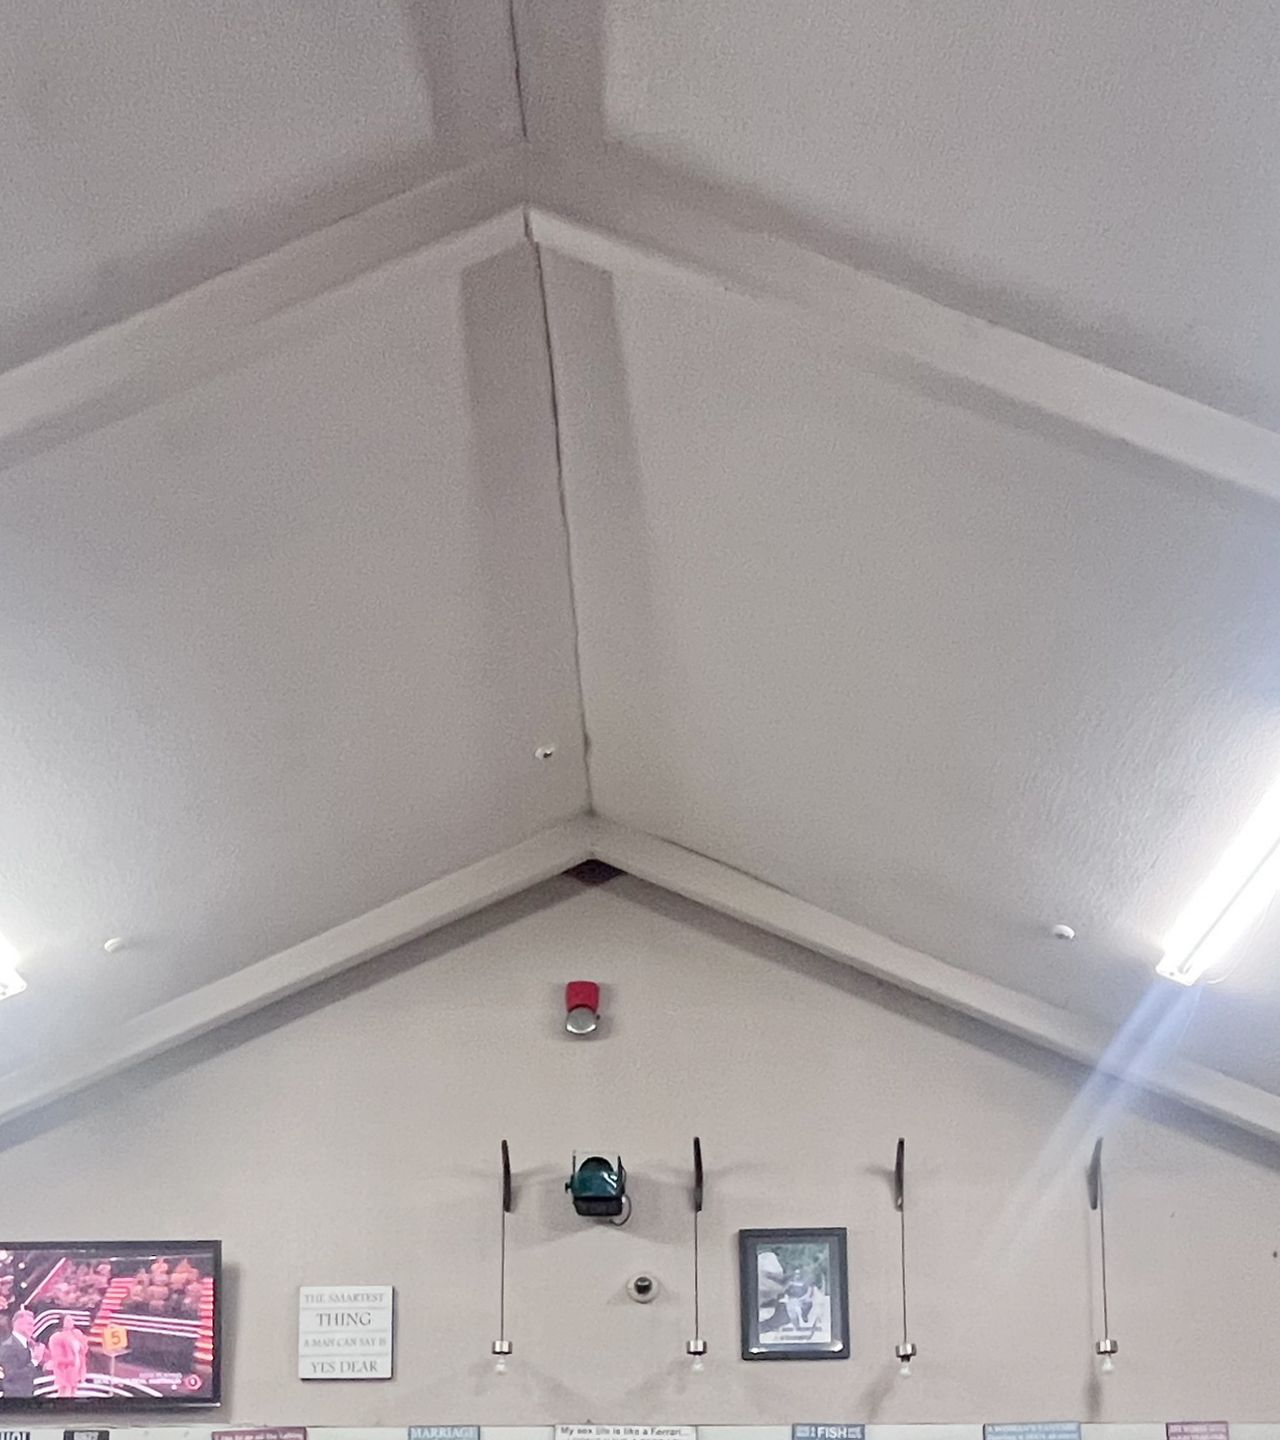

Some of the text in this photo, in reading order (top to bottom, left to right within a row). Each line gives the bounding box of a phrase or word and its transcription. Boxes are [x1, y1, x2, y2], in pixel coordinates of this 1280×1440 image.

[304, 1292, 384, 1303] THE SMARTEST
[316, 1312, 371, 1326] THING
[111, 1332, 121, 1345] 5
[304, 1339, 309, 1347] A
[311, 1339, 335, 1347] MAN
[337, 1338, 357, 1347] CAN
[360, 1337, 376, 1346] SAY
[311, 1360, 378, 1373] YES DEAR
[410, 1427, 477, 1438] MARRIAGE
[561, 1426, 575, 1436] My
[613, 1427, 621, 1435] is
[623, 1427, 640, 1435] like
[817, 1426, 847, 1438] FISH
